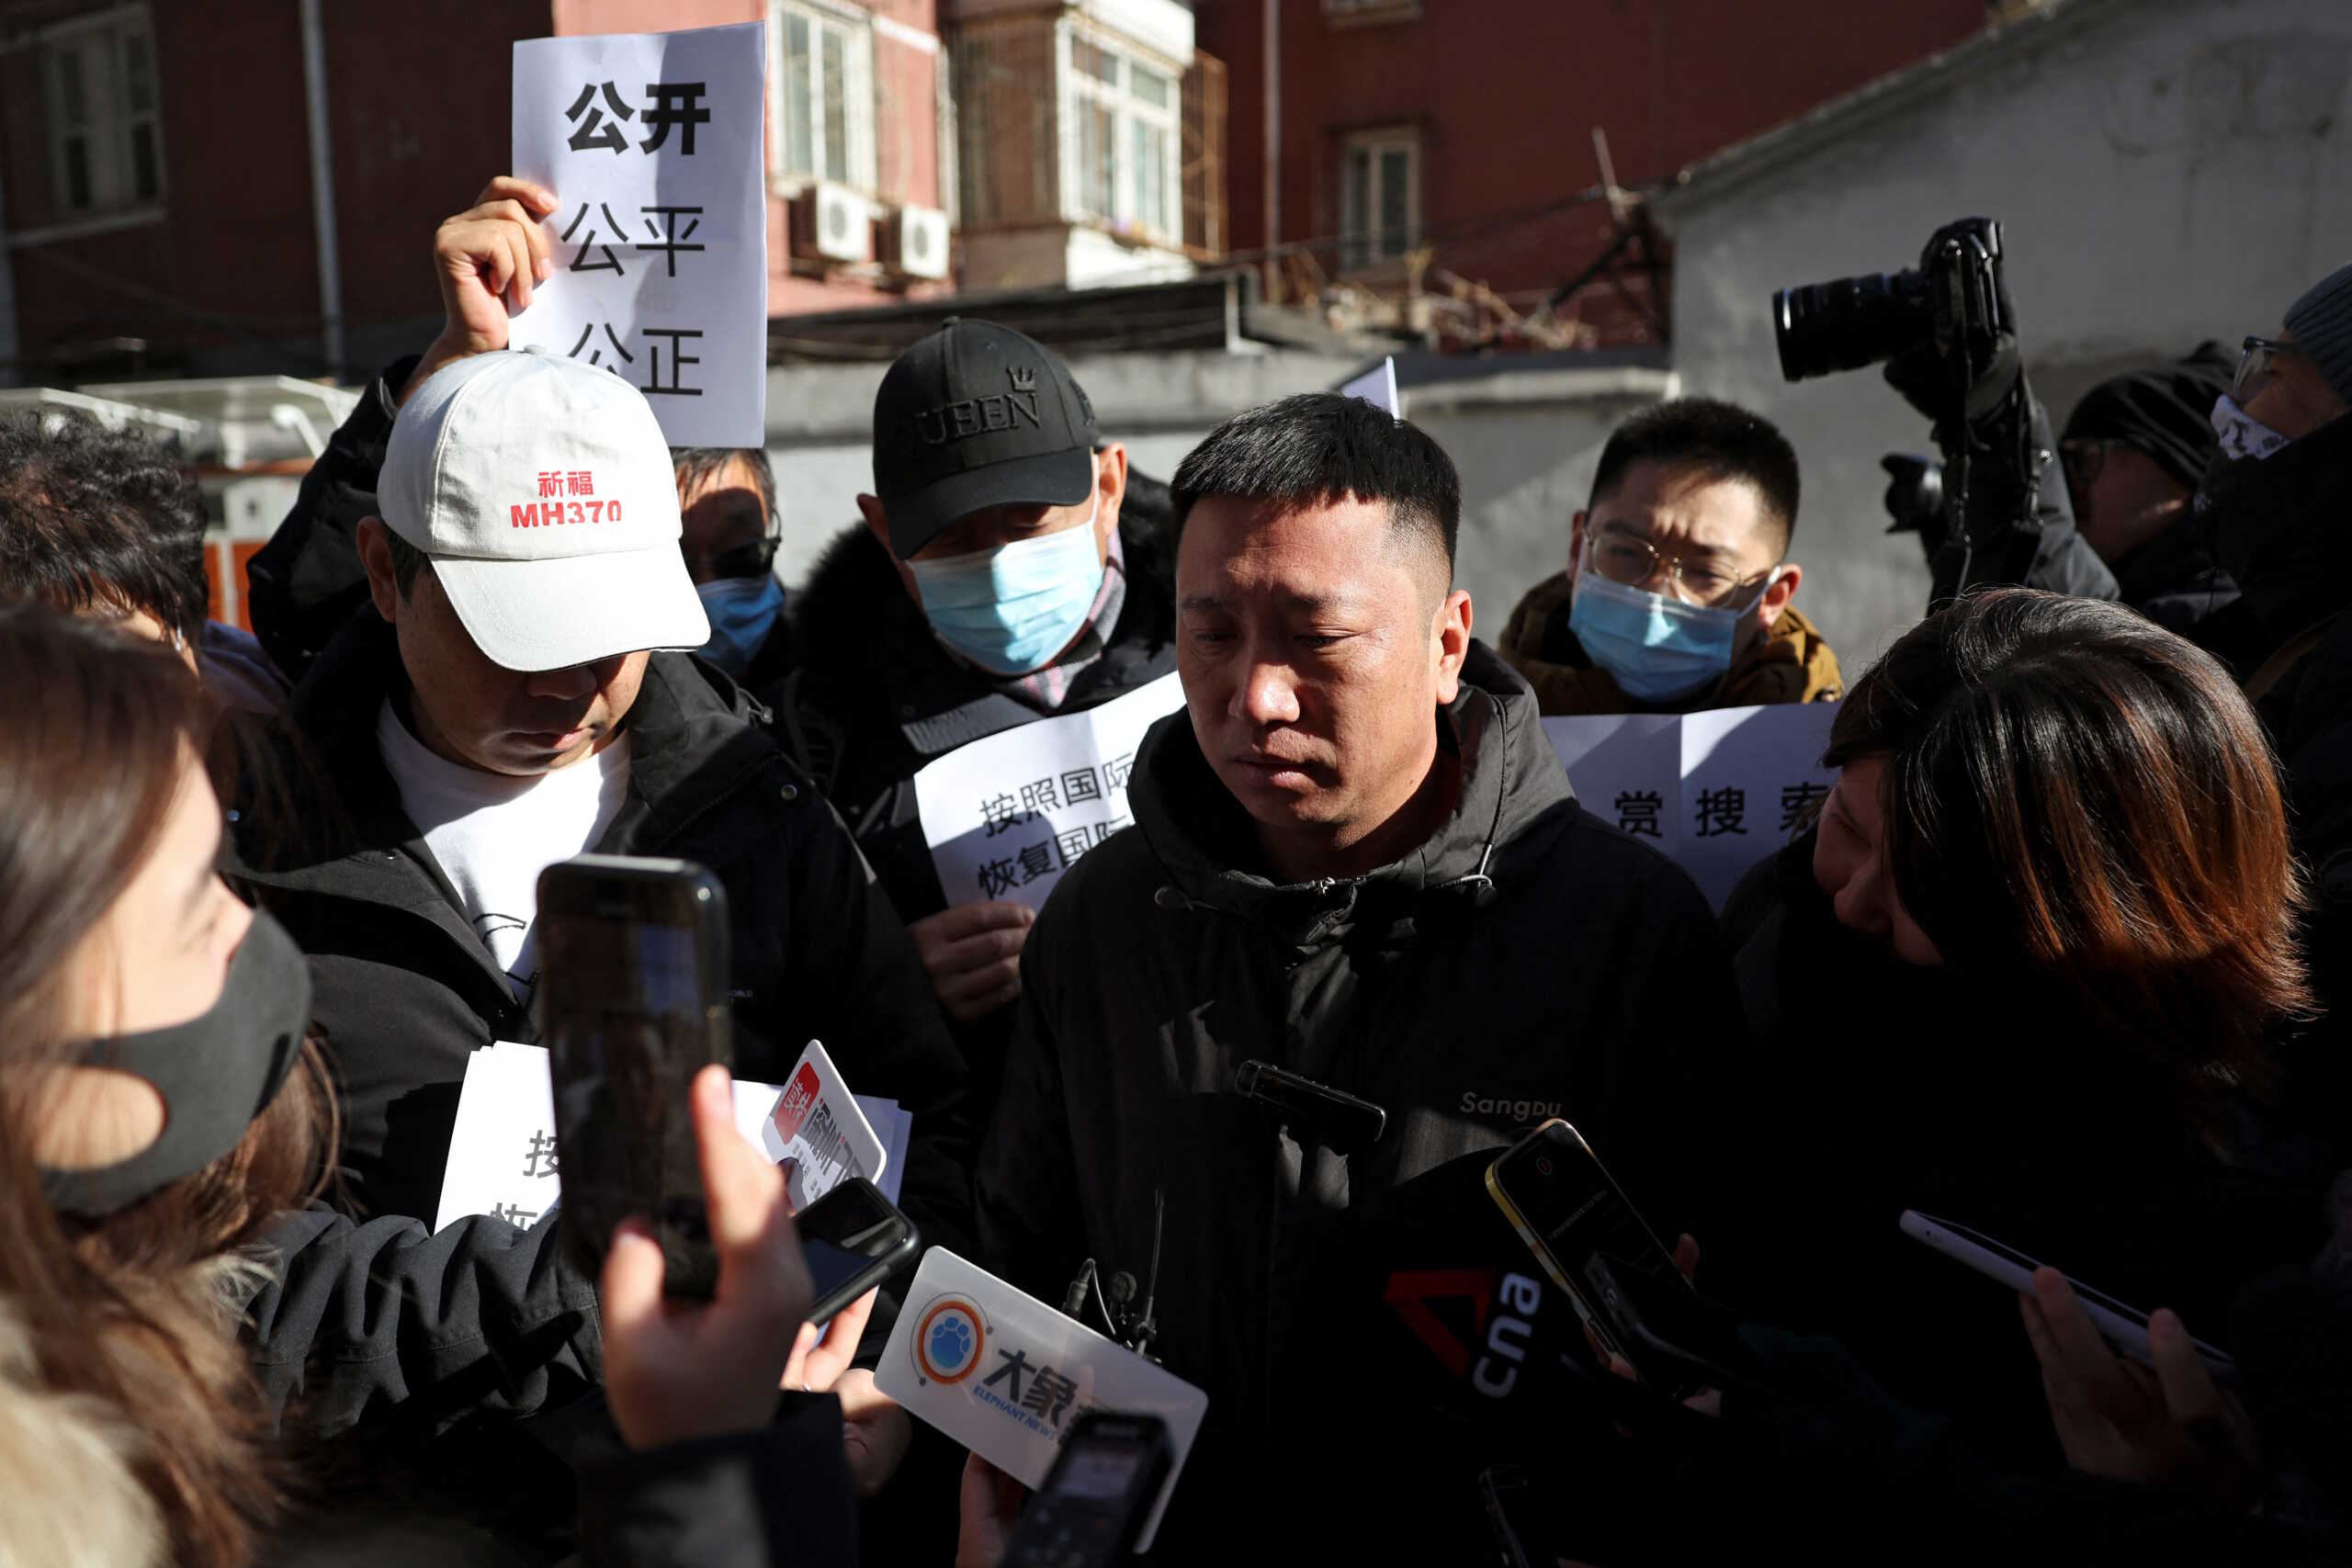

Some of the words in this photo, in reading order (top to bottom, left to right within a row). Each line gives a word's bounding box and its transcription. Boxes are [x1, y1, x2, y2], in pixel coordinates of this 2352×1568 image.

[564, 81, 710, 155] 公开
[560, 202, 705, 276] 公平
[537, 470, 594, 498] 祈福
[510, 500, 622, 528] MH370
[1472, 1272, 1542, 1398] cna
[973, 1384, 1028, 1423] ELEPHANT
